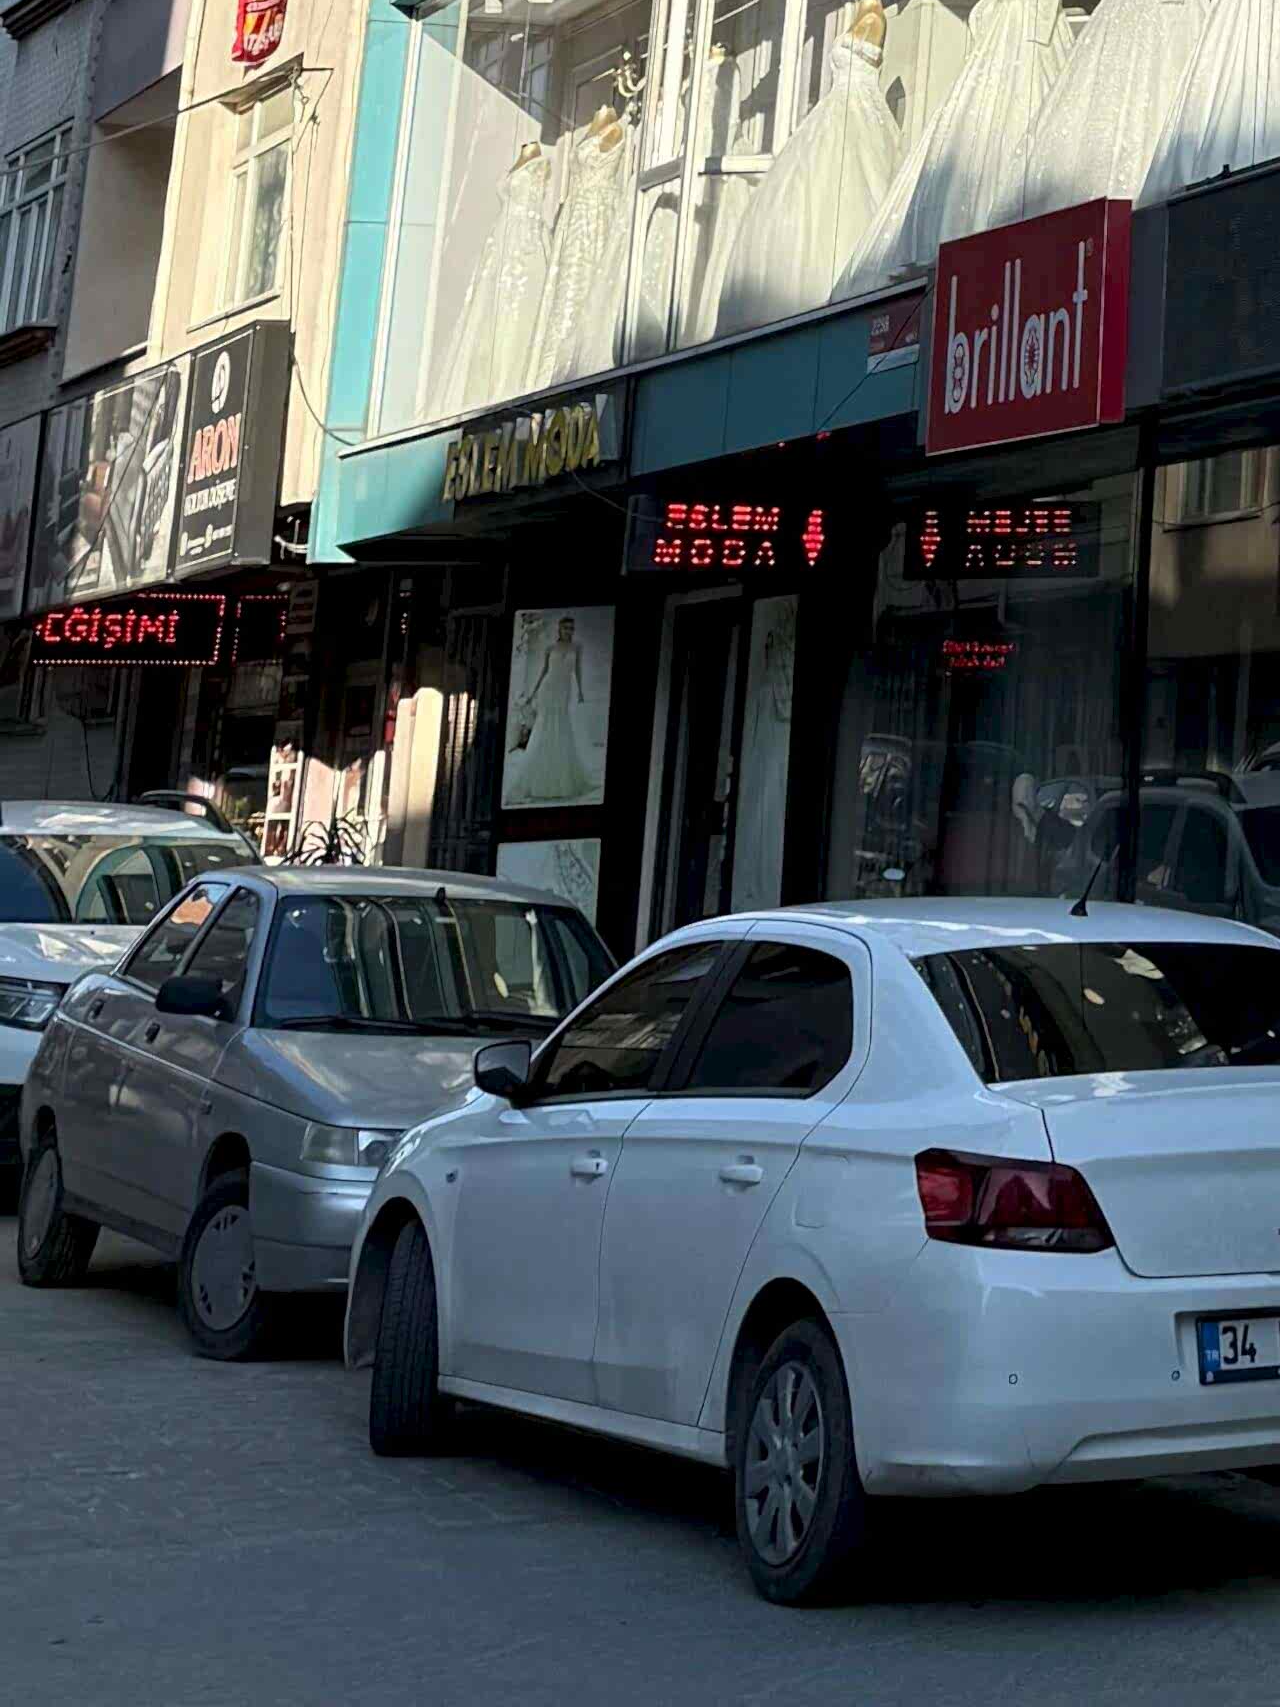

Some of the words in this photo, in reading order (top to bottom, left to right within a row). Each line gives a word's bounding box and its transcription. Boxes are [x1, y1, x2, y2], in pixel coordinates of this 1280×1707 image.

[943, 240, 1089, 415] brillant
[187, 413, 242, 484] ARON
[665, 502, 780, 531] ESLEM
[653, 538, 775, 566] MODA
[1221, 1324, 1257, 1365] 34
